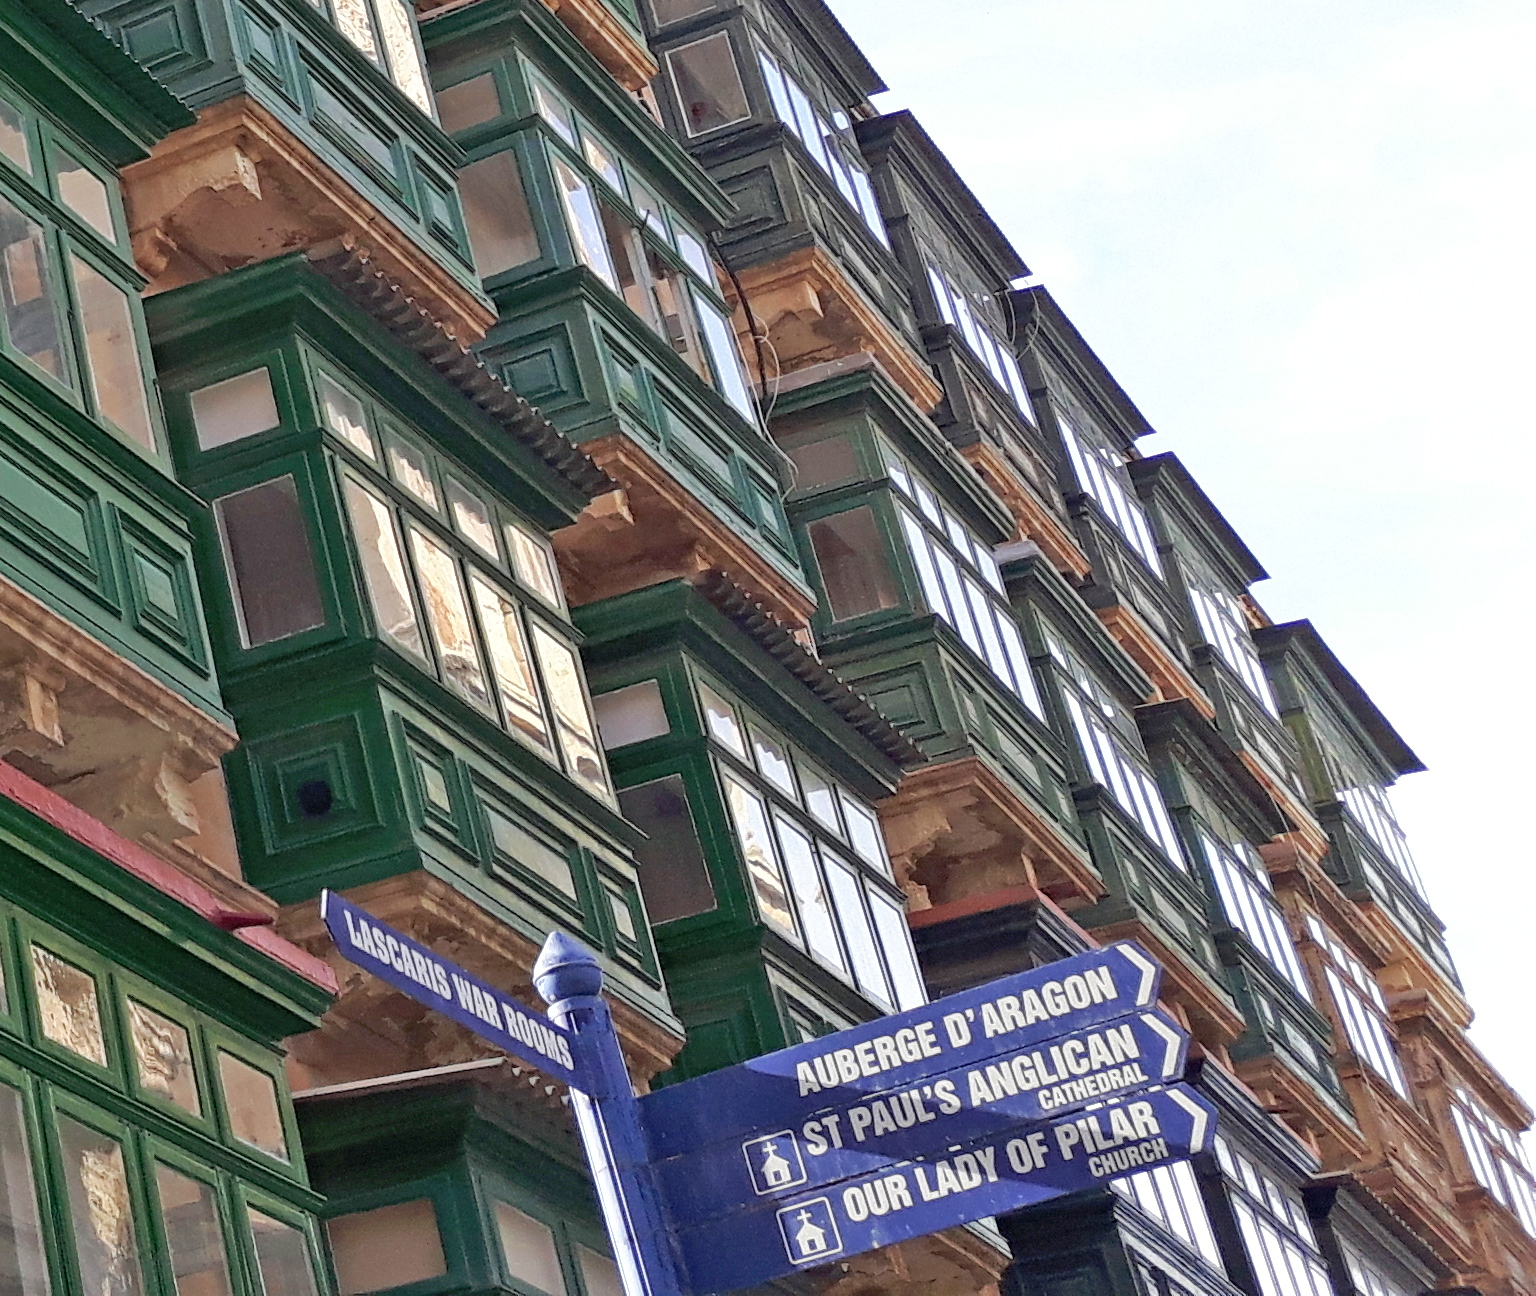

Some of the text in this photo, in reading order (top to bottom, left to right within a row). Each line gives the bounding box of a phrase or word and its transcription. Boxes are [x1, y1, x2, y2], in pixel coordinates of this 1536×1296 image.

[343, 909, 575, 1071] LASCARIS WAR ROOMS
[796, 1021, 941, 1097] AUBERGE
[802, 1024, 1141, 1157] ST PAUL'S ANGLICAN
[1038, 1062, 1149, 1111] CATHEDRAL
[842, 1100, 1161, 1223] OUR LADY OF PILAR
[1089, 1137, 1169, 1179] CHURCH
